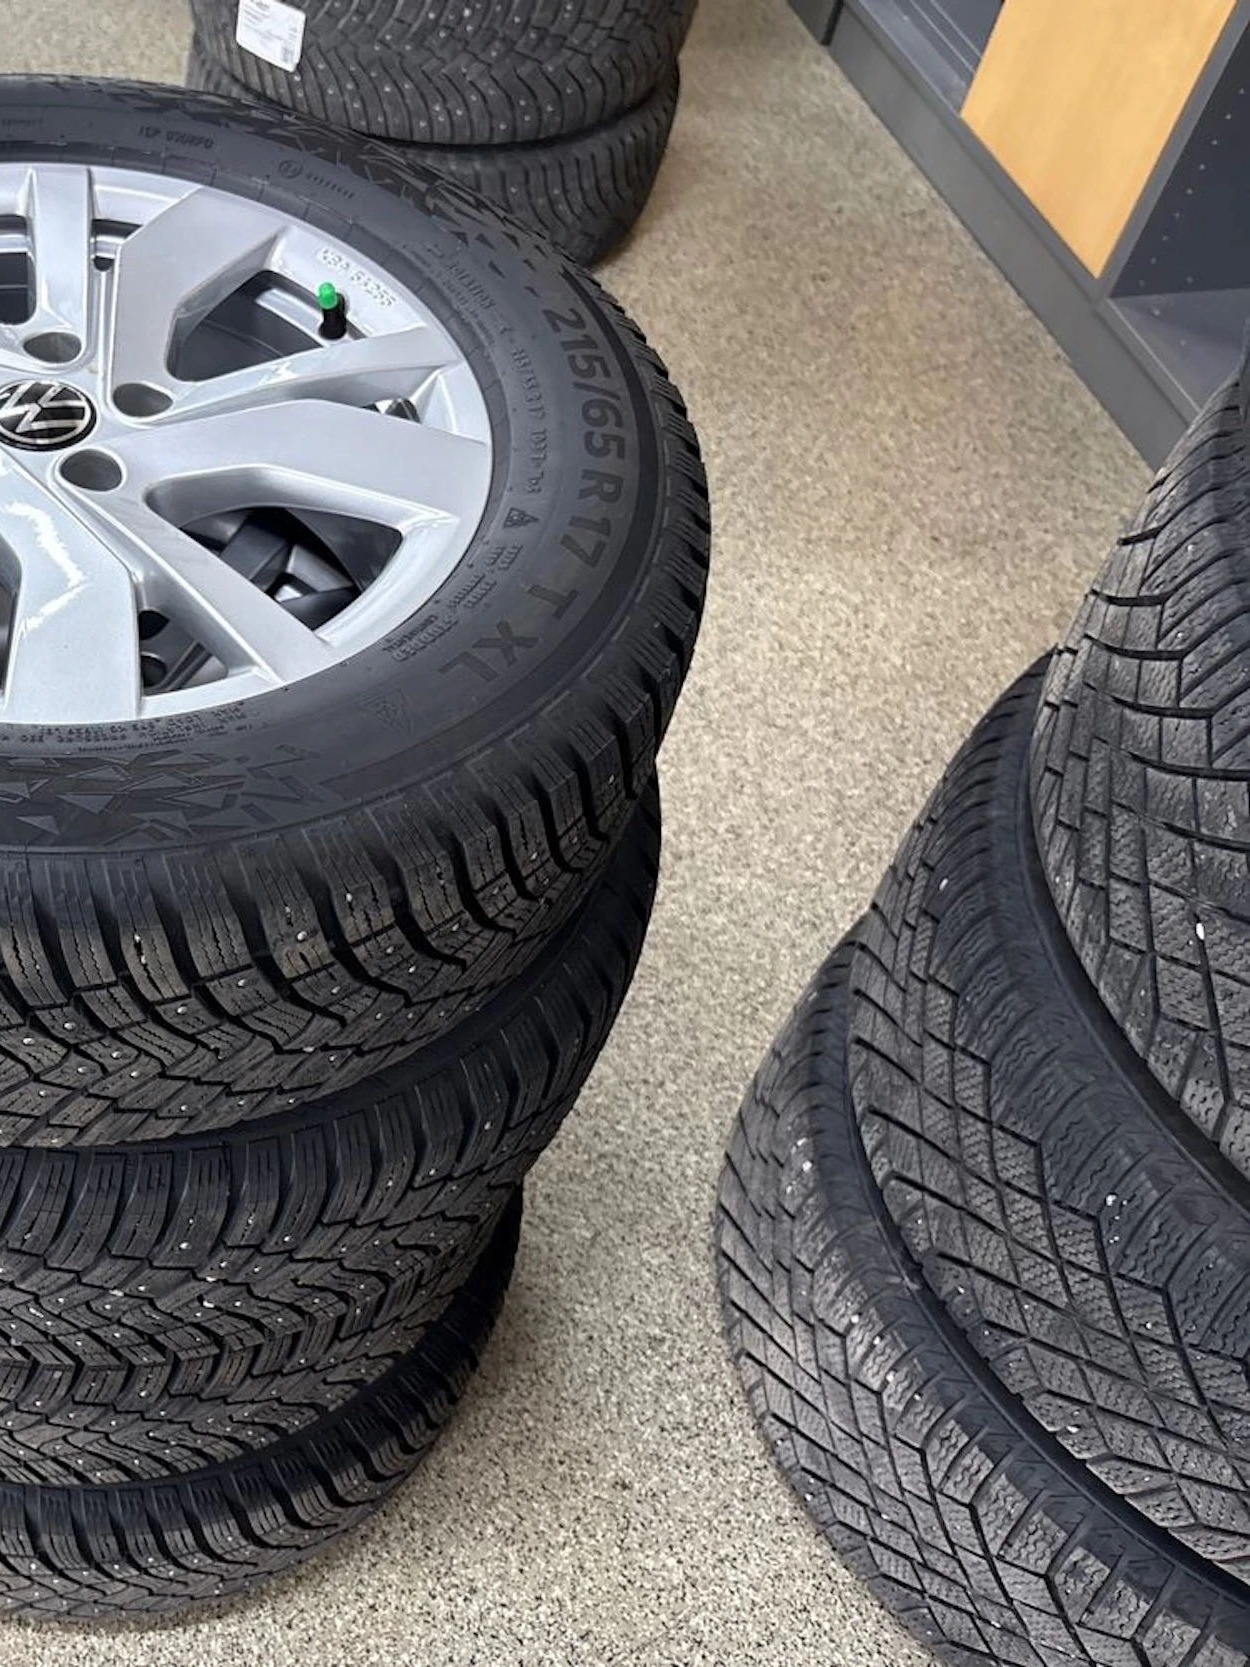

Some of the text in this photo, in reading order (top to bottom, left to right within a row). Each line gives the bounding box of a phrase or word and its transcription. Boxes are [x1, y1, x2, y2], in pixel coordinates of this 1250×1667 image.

[542, 307, 626, 460] 215/65
[528, 583, 580, 621] T
[438, 620, 540, 683] XL
